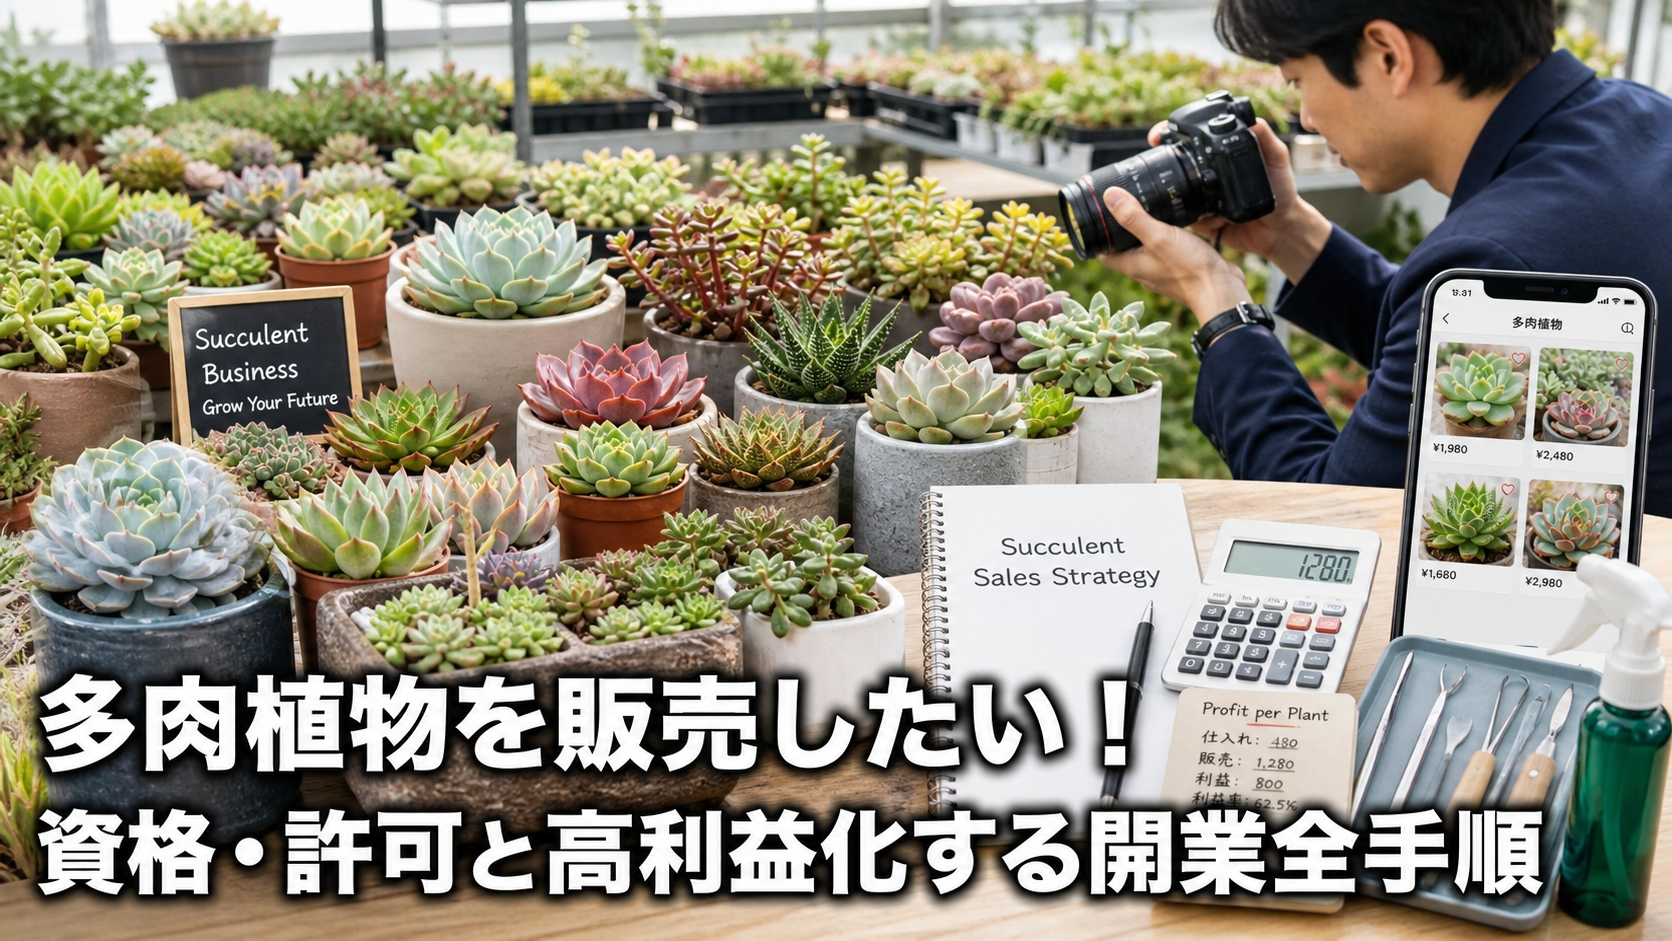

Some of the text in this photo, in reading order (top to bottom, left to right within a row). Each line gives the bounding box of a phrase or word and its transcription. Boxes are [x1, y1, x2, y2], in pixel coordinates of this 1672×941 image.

[195, 322, 309, 351] Succulent
[202, 361, 299, 385] Business
[202, 392, 339, 416] Grow Your Future
[1433, 442, 1468, 454] ¥1,980
[1536, 449, 1574, 462] ¥2,480
[1001, 536, 1126, 556] Succulent
[974, 567, 1161, 589] Sales Strategy
[1421, 568, 1457, 580] ¥1,680
[1525, 576, 1563, 588] ¥2,980
[1202, 701, 1329, 723] Profit per Plant
[1271, 737, 1298, 748] 480
[1257, 757, 1295, 769] 1,280
[1255, 777, 1284, 789] 800
[1254, 798, 1298, 812] 62.5%
